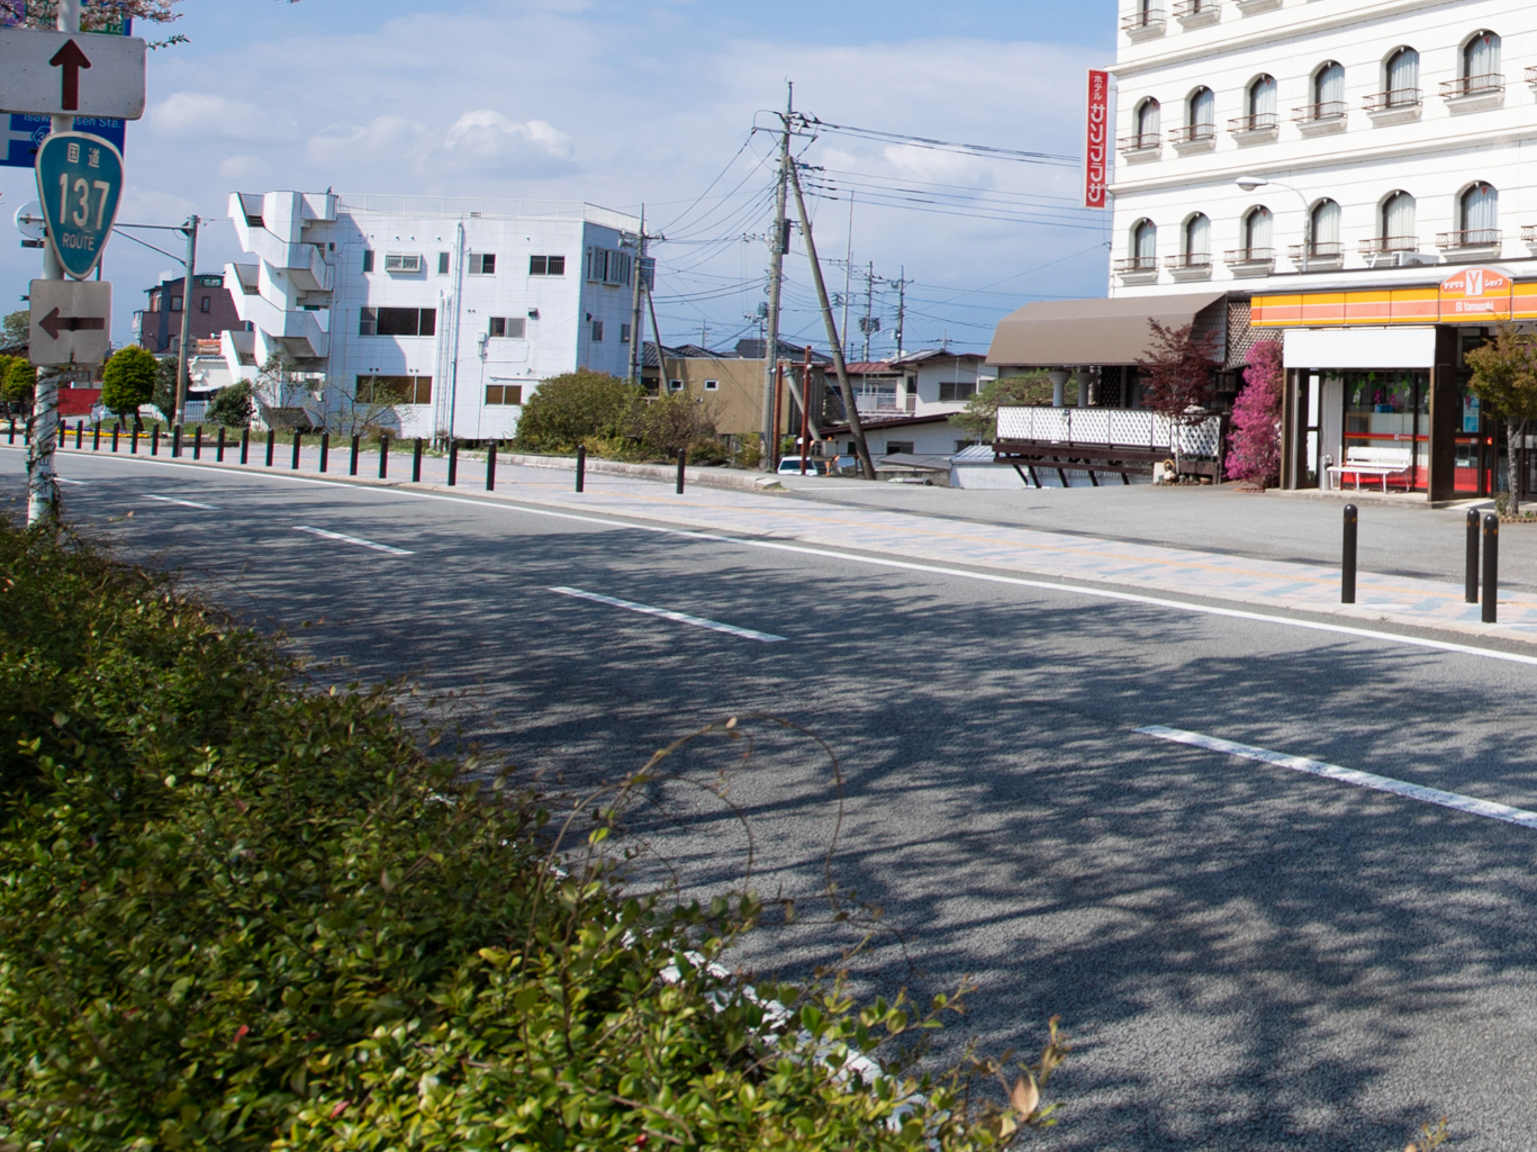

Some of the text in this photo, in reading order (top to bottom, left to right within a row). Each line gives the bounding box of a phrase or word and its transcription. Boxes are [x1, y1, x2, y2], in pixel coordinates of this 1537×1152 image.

[1093, 75, 1103, 100] ホテル
[67, 142, 100, 168] 国道
[1088, 103, 1106, 202] サンプラザ
[59, 173, 110, 230] 137
[62, 233, 95, 251] ROUTE
[1467, 272, 1480, 294] Y
[1463, 300, 1494, 312] Yamazaki
